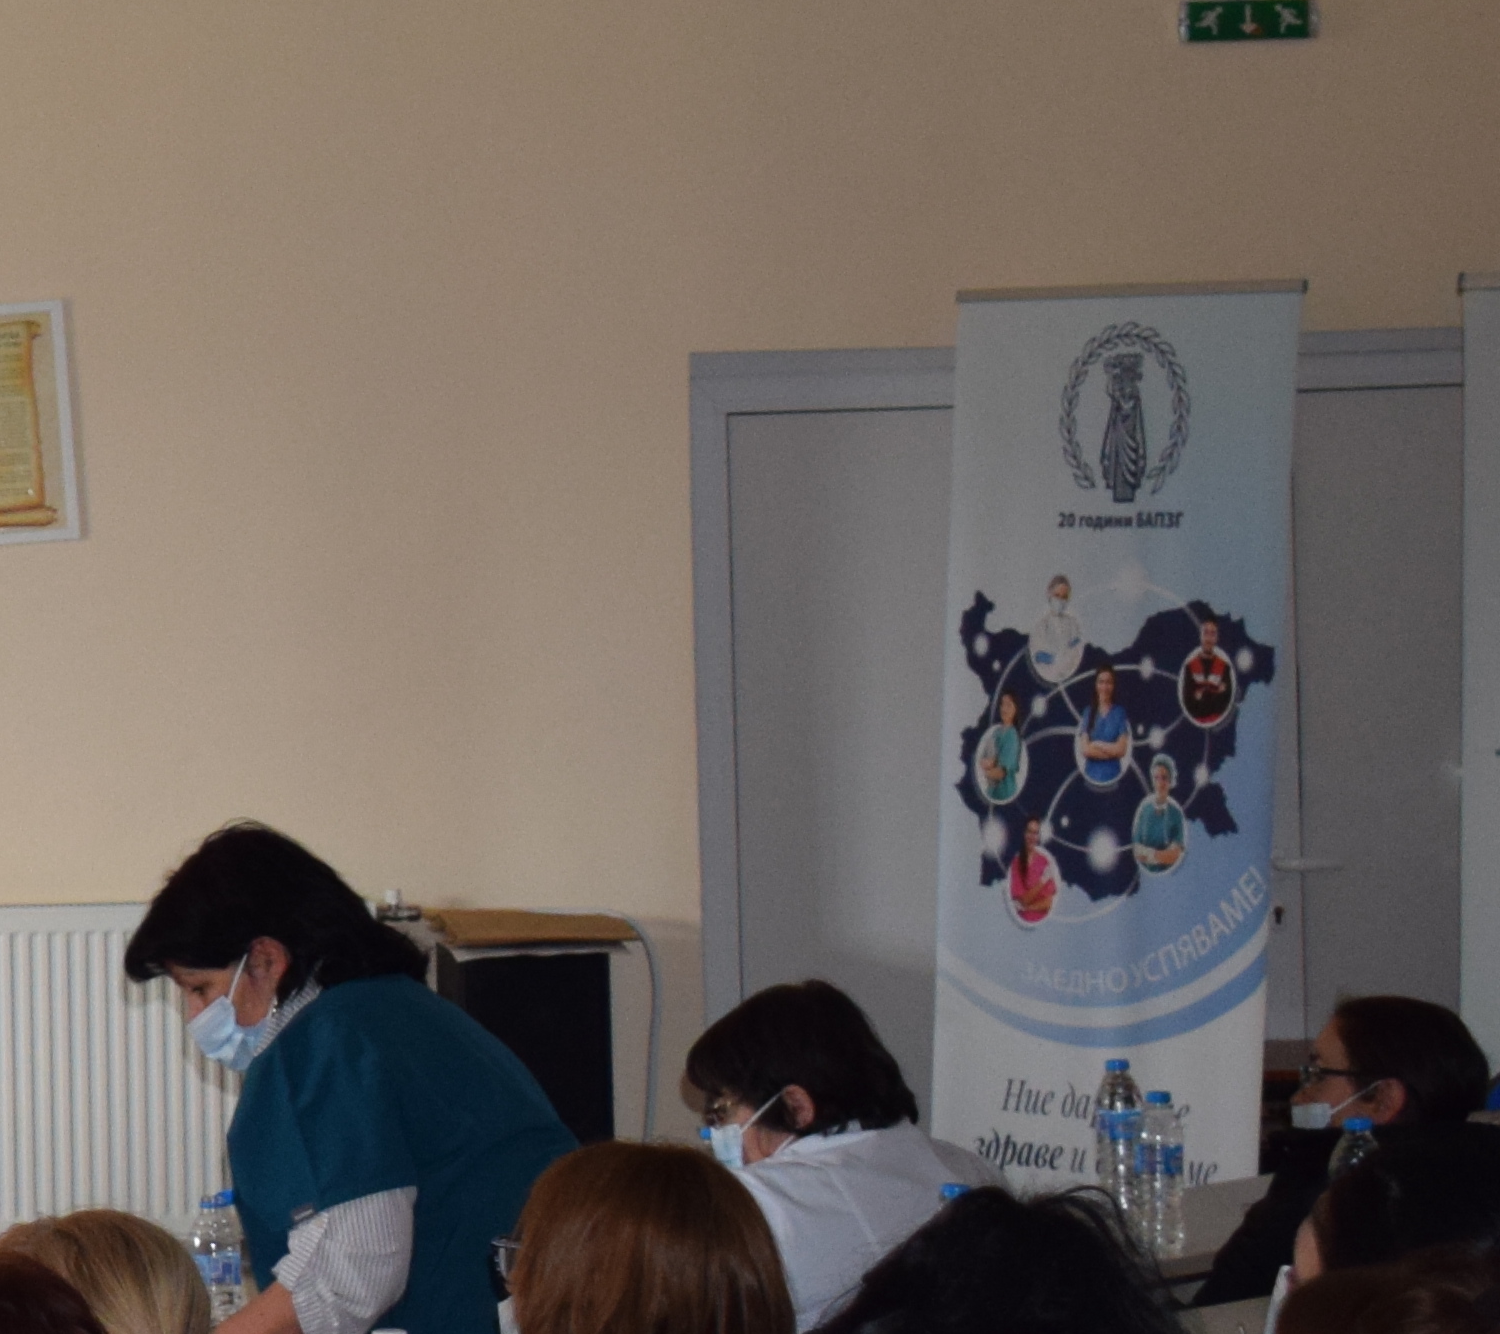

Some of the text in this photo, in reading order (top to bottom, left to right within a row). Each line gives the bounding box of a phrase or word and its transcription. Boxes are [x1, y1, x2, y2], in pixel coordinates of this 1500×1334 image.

[1057, 512, 1076, 528] 20
[1079, 516, 1133, 531] години
[1021, 865, 1268, 997] ЗАЕДНО УСПЯВАМЕ!
[1002, 1078, 1055, 1116] Ние
[1070, 1147, 1087, 1174] и
